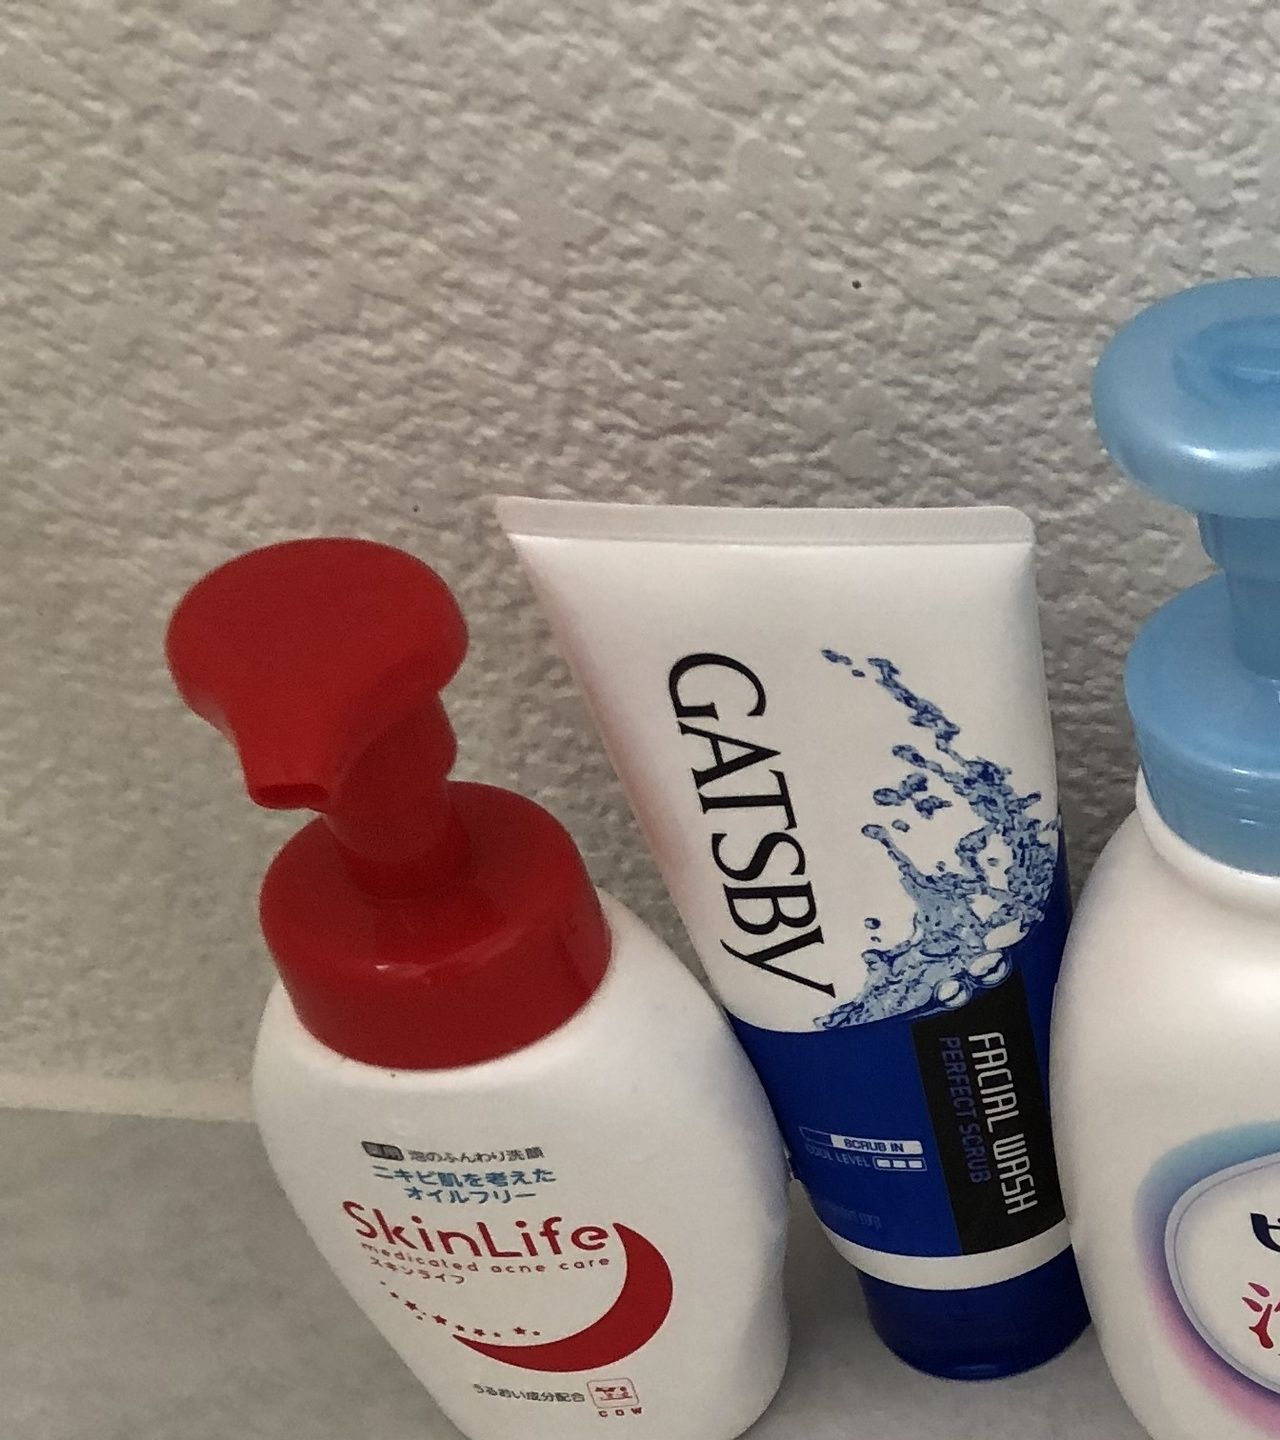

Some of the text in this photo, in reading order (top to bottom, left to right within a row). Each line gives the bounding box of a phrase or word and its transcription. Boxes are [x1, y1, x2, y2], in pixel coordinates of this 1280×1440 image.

[668, 652, 836, 998] GATSBY
[938, 1035, 992, 1184] PERFECT SCRUB
[968, 1031, 1038, 1215] FACIAL WASH
[843, 1138, 905, 1153] SCRUB IN
[371, 1164, 557, 1188] ニキビ肌を考えた
[403, 1186, 536, 1204] オイルフリー
[342, 1200, 610, 1258] SkinLife
[360, 1242, 611, 1274] medicated acne care
